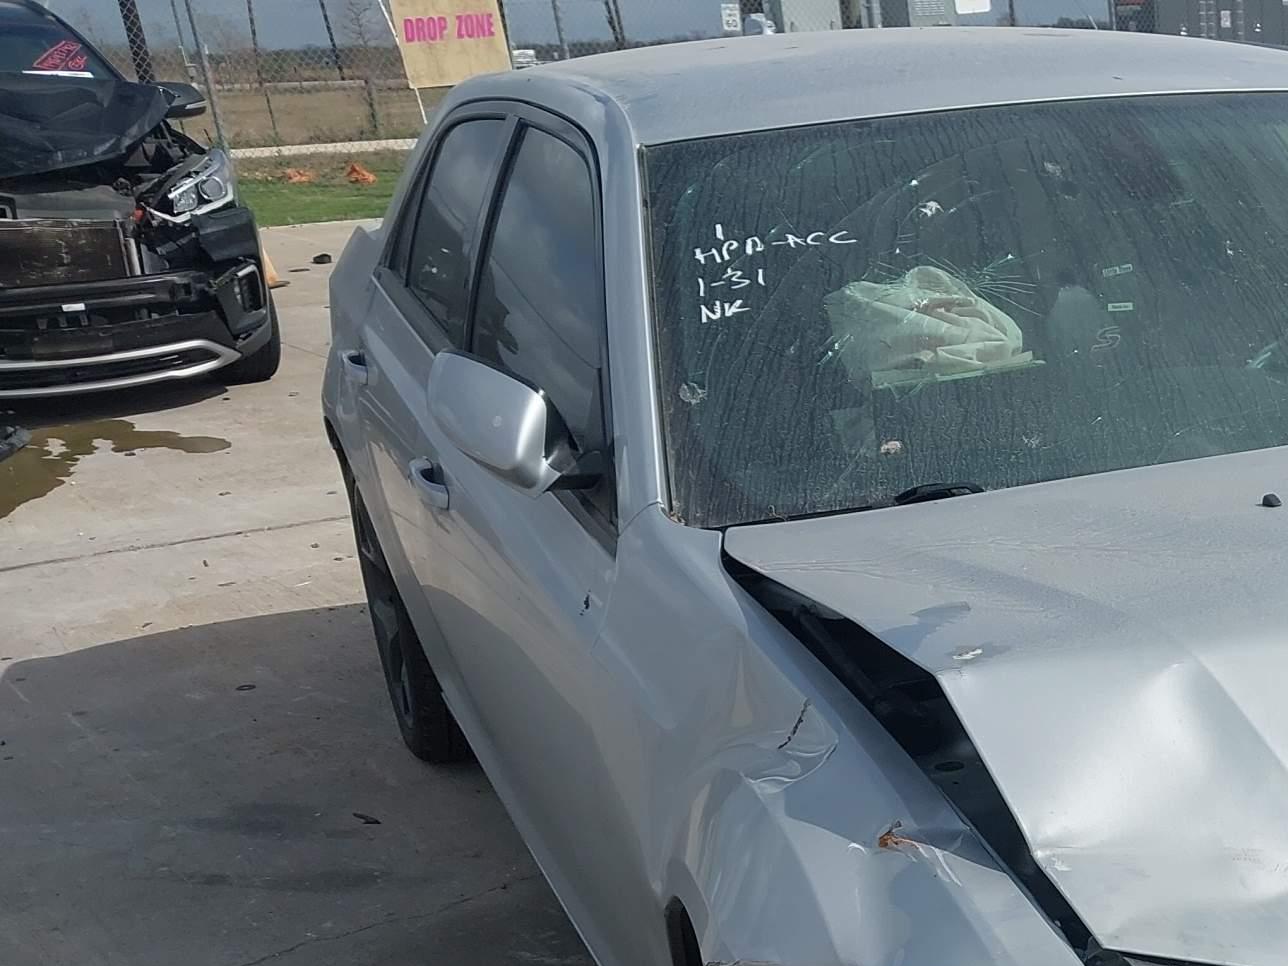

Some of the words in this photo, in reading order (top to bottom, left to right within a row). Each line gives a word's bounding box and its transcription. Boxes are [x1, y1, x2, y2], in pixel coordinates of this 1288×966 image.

[403, 16, 447, 43] DROP
[455, 13, 495, 39] ZONE
[698, 267, 766, 297] 1-31
